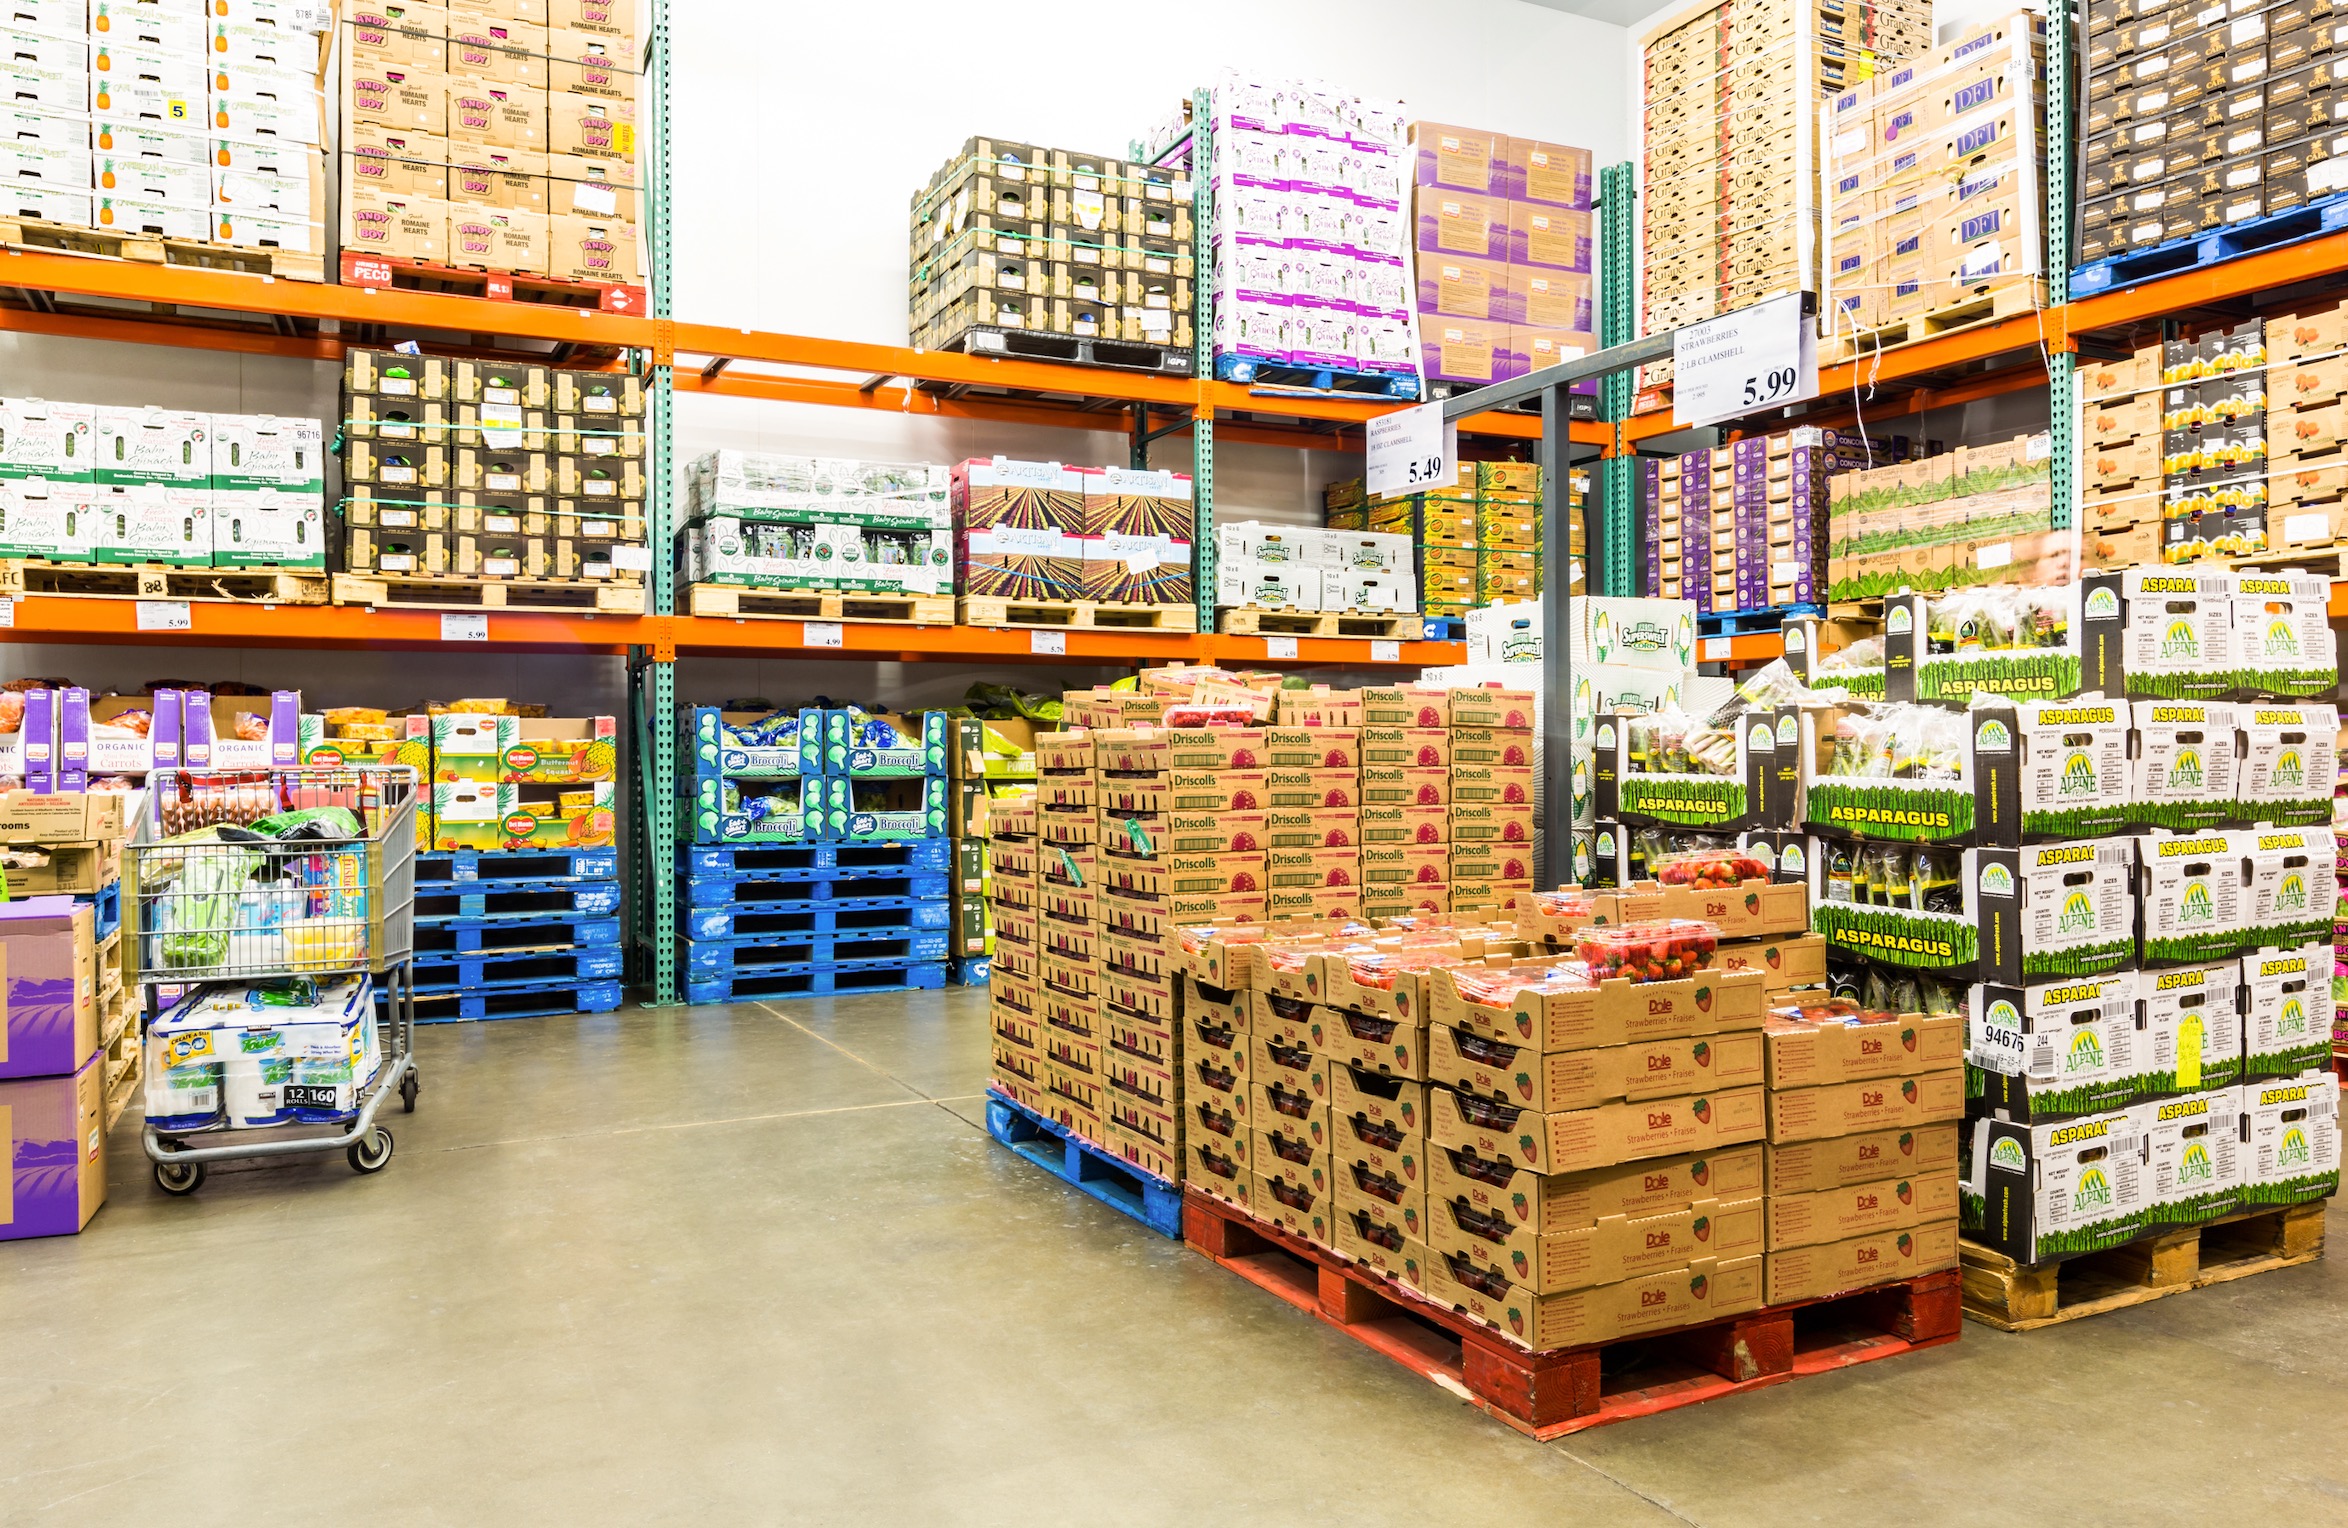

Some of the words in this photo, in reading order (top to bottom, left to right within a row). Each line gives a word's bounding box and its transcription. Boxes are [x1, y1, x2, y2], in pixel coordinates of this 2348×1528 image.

[1879, 10, 1914, 32] Grapes
[359, 31, 384, 44] BOY
[2204, 42, 2226, 56] CAPA
[2309, 39, 2333, 53] CAPA
[1893, 70, 1912, 86] DFI
[2206, 76, 2227, 90] CAPA
[355, 80, 389, 94] ANDY
[399, 90, 429, 100] ROMAINE
[1957, 82, 1993, 110] DFI
[358, 97, 384, 110] BOY
[401, 98, 427, 108] HEARTS
[459, 98, 493, 112] ANDY
[172, 105, 184, 117] 5
[501, 107, 530, 118] ROMAINE
[2112, 107, 2132, 119] CAPA
[463, 116, 489, 128] BOY
[503, 115, 528, 125] HEARTS
[1960, 124, 1995, 152] DFI
[1735, 168, 1774, 189] Grapes
[356, 211, 390, 223] ANDY
[1654, 200, 1688, 221] Grapes
[401, 220, 431, 229] ROMAINE
[403, 227, 428, 236] HEARTS
[1963, 211, 1999, 238] DFI
[354, 266, 391, 281] PECO
[1735, 257, 1774, 276] Grapes
[1680, 328, 1739, 352] STRAWBERRIES
[1680, 362, 1685, 371] 2
[1686, 359, 1697, 369] LB
[1697, 346, 1745, 366] CLAMSHELL
[1743, 367, 1796, 406] 5.99
[296, 429, 321, 440] 96716
[1370, 424, 1402, 437] RASPBERRIES
[1383, 435, 1412, 448] CLAMSHELL
[7, 447, 55, 463] Spinach
[1009, 467, 1058, 480] ARTISAN
[1409, 456, 1441, 483] 5.49
[1122, 474, 1168, 487] ARTISAN
[752, 508, 773, 518] Baby
[772, 509, 800, 519] Spinach
[872, 515, 891, 525] Baby
[890, 515, 917, 528] Spinach
[1009, 532, 1058, 546] ARTISAN
[753, 574, 773, 585] Baby
[772, 576, 801, 587] Spinach
[168, 619, 189, 627] 5.99
[467, 631, 486, 640] 5.99
[1632, 641, 1656, 650] CORN
[2161, 641, 2199, 659] ALPINE
[1512, 655, 1533, 663] CORN
[1940, 676, 2056, 695] ASPARAGUS
[1366, 690, 1404, 704] Driscoll's
[1455, 691, 1491, 705] Driscoll's
[2038, 707, 2115, 726] ASPARAGUS
[1366, 728, 1404, 742] Driscoll's
[96, 742, 146, 751] ORGANIC
[218, 744, 265, 752] ORGANIC
[518, 754, 536, 762] Monte
[750, 754, 788, 766] Broccoli
[879, 754, 919, 766] Broccoli
[2064, 749, 2075, 762] PEAK
[2076, 748, 2094, 761] QUALITY
[100, 758, 142, 768] Carrots
[540, 759, 579, 767] Butternut
[1006, 761, 1036, 772] POWER
[2059, 775, 2098, 794] ALPINE
[1637, 797, 1728, 814] ASPARAGUS
[1364, 807, 1403, 822] Driscoll's
[1830, 805, 1950, 828] ASPARAGUS
[517, 821, 535, 829] Monte
[754, 819, 797, 833] Broccoli
[2158, 837, 2229, 857] ASPARAGUS
[1366, 886, 1404, 899] Driscoll's
[2178, 904, 2214, 922] ALPINE
[1649, 997, 1673, 1015] Dole
[1625, 1017, 1668, 1029] Strawberries
[1672, 1014, 1696, 1023] Fraises
[1860, 1038, 1883, 1054] Dole
[1985, 1025, 2024, 1053] 94676
[2037, 1035, 2048, 1047] 244
[1647, 1053, 1672, 1071] Dole
[1625, 1071, 1669, 1086] Strawberries
[1671, 1067, 1696, 1080] Fraises
[288, 1088, 305, 1099] 12
[309, 1089, 336, 1103] 160
[1647, 1111, 1672, 1130] Dole
[1626, 1129, 1670, 1145] Strawberries
[1673, 1124, 1697, 1137] Fraises
[2056, 1167, 2070, 1175] WEIGHT
[1621, 1192, 1665, 1207] Strawberries
[1668, 1187, 1693, 1200] Fraises
[2072, 1186, 2112, 1212] ALPINE
